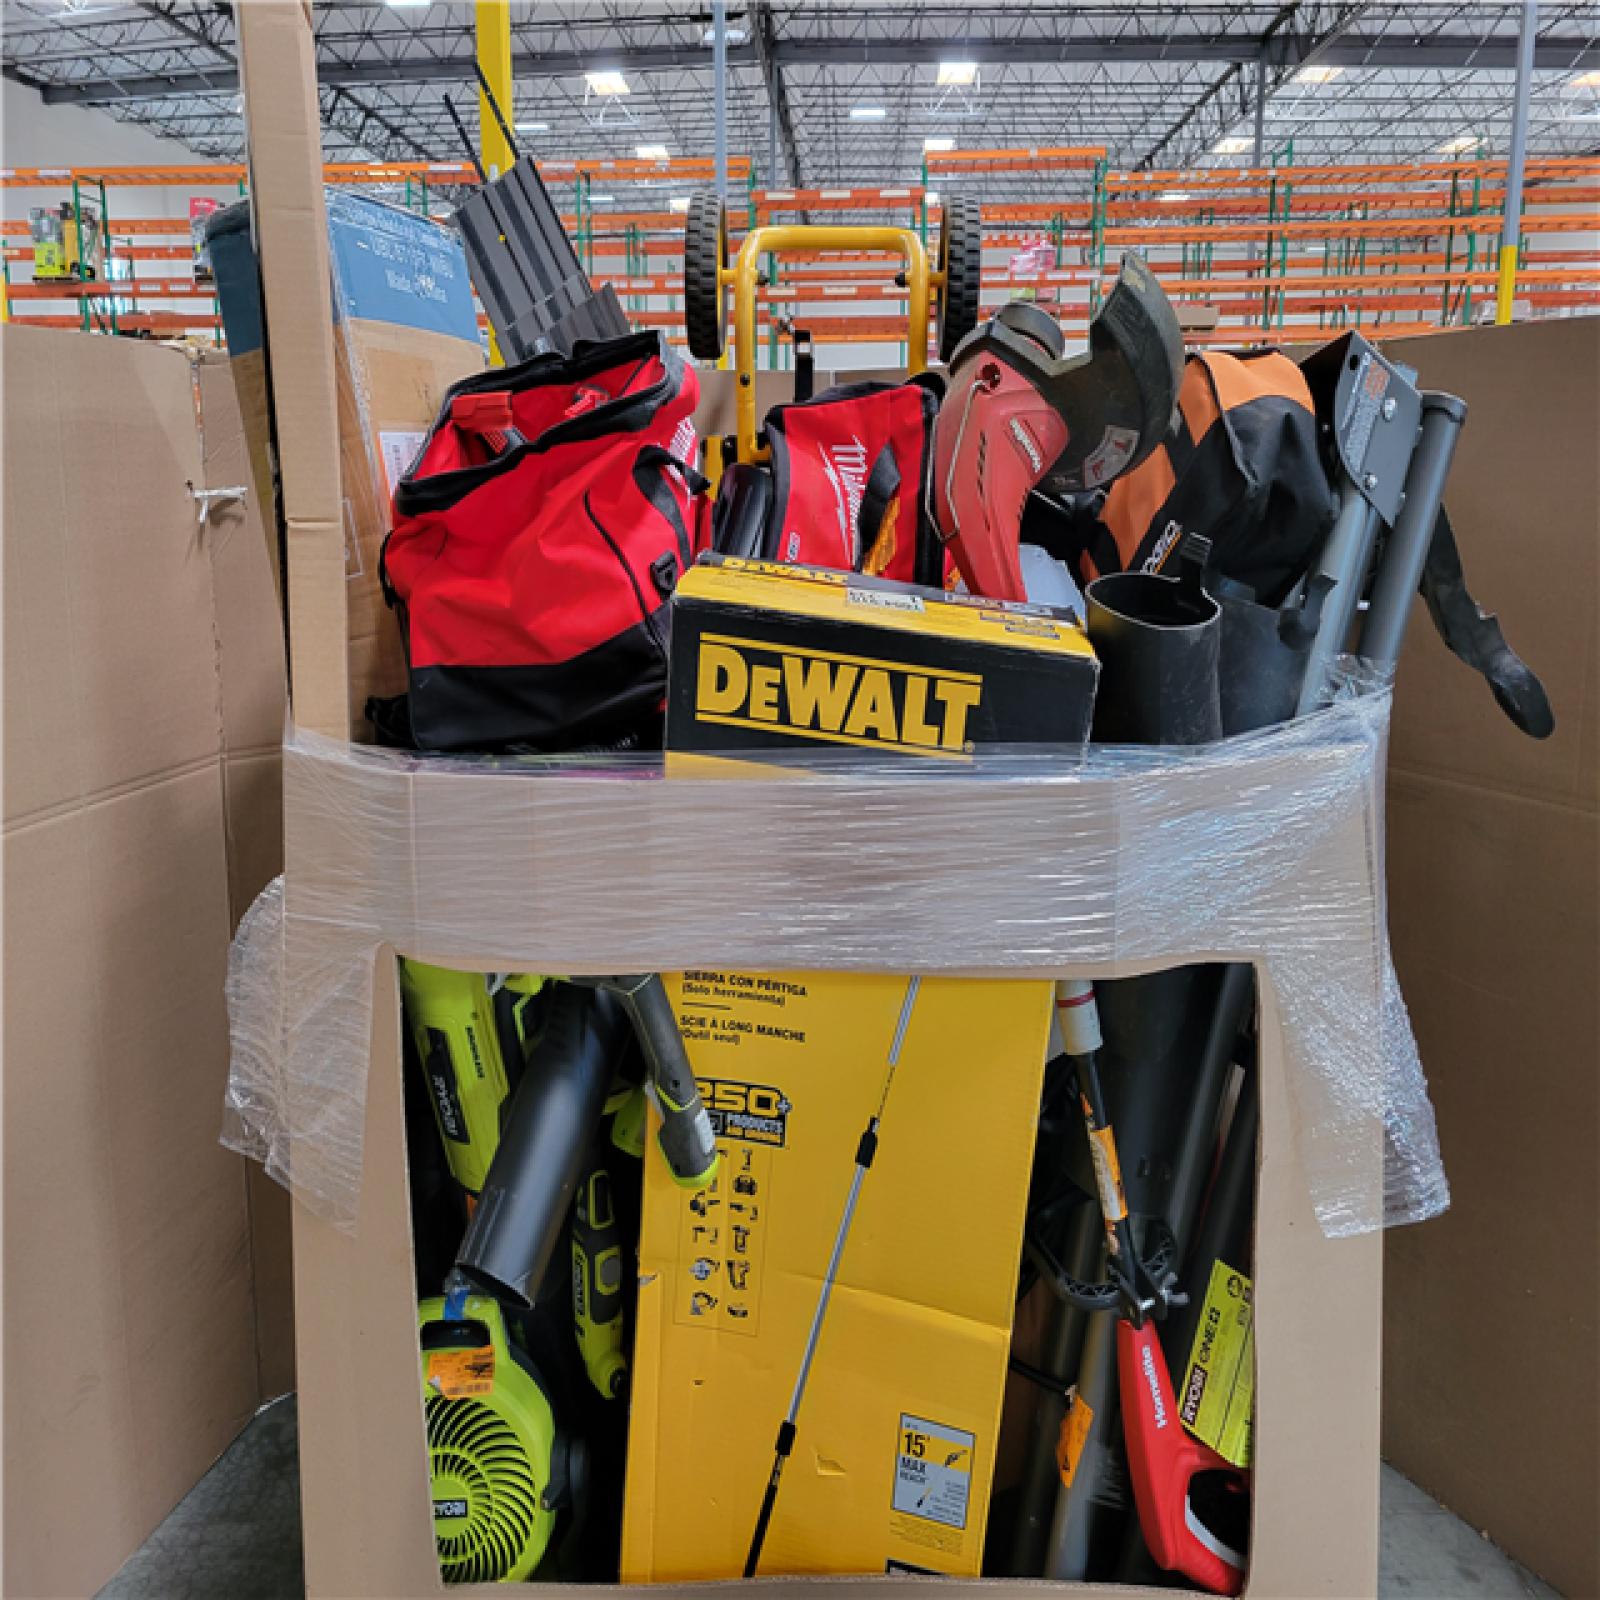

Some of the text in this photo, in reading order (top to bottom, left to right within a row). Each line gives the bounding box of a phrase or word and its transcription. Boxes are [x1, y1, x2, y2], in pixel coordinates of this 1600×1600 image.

[696, 643, 981, 751] DEWALT
[729, 975, 754, 988] CON
[721, 1019, 753, 1034] LONG
[757, 1024, 806, 1043] MANCHE
[901, 1457, 928, 1476] MAX
